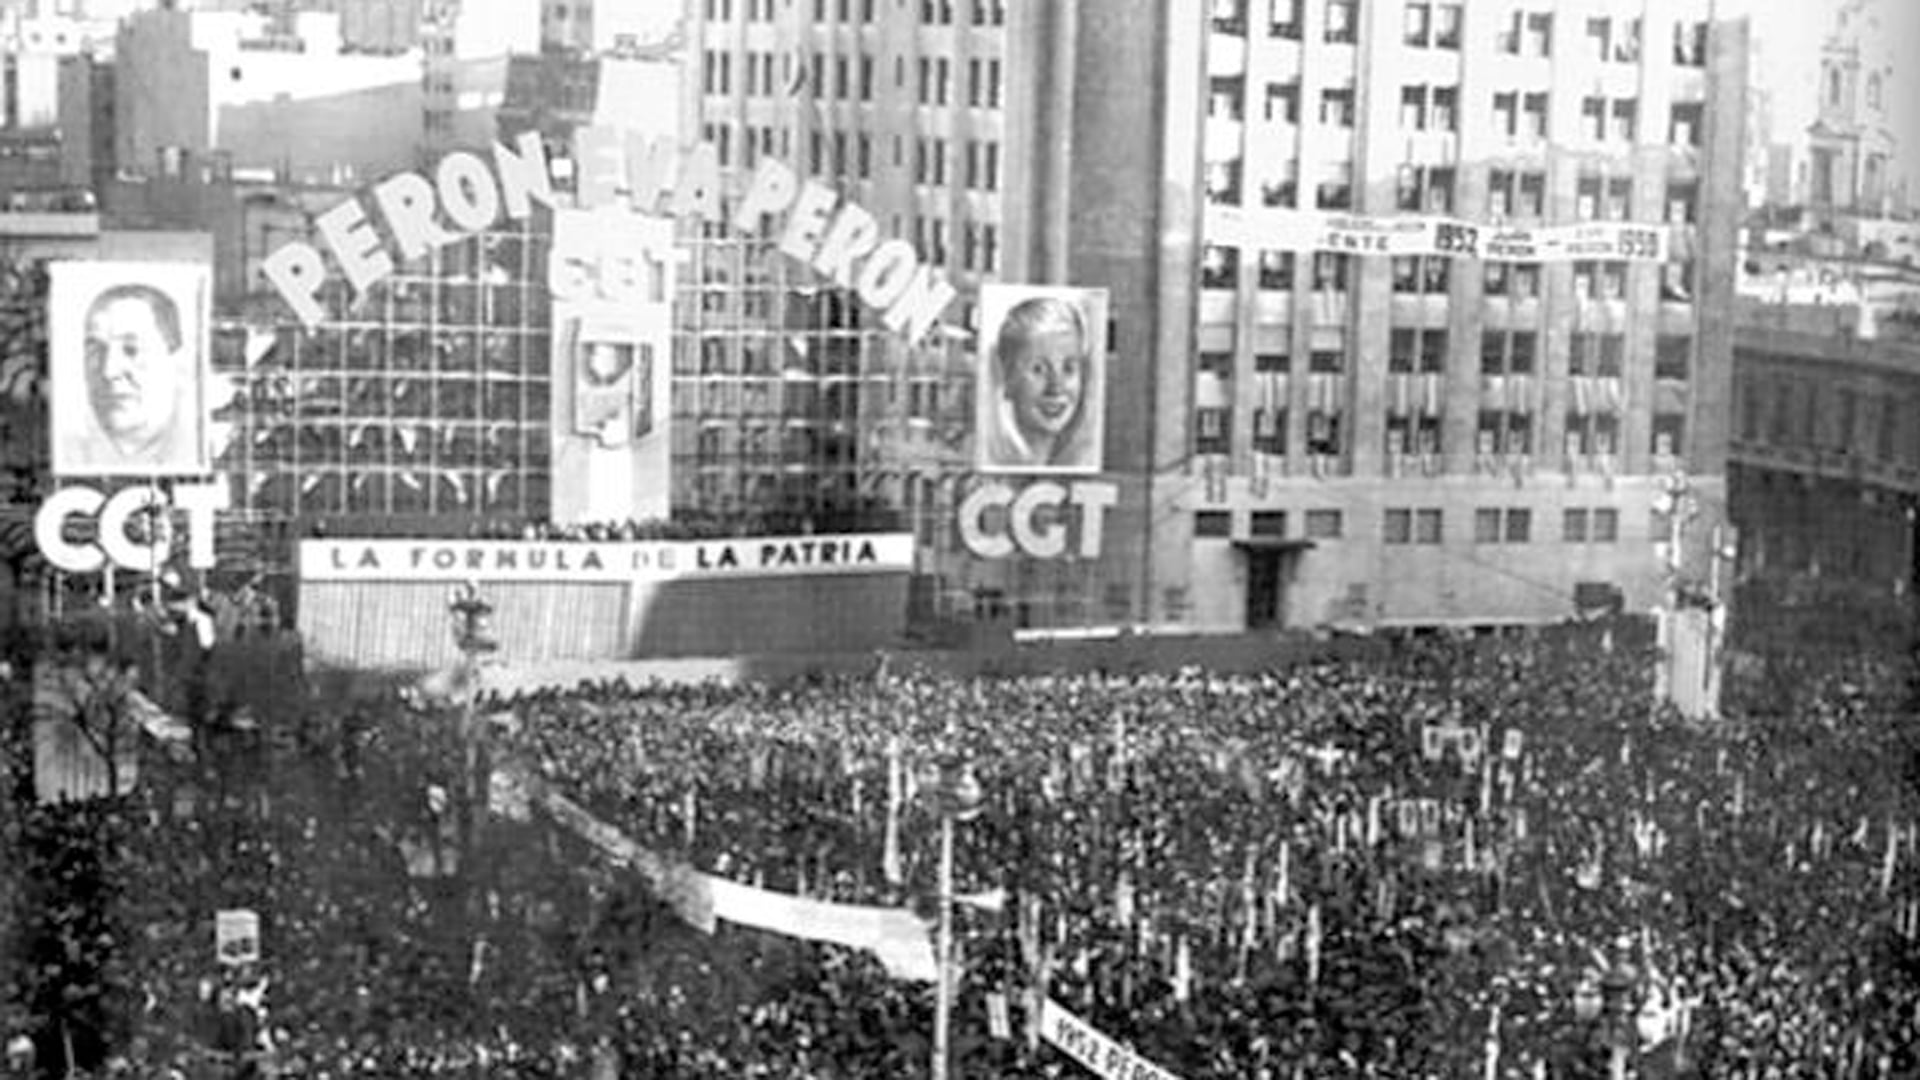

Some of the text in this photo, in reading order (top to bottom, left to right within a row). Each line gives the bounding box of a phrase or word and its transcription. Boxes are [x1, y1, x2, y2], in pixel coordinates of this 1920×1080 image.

[574, 125, 721, 222] EVA
[263, 130, 560, 334] PERON
[734, 154, 958, 347] PERON
[331, 540, 877, 571] LA FORMULA DE LA PATRIA
[957, 480, 1119, 560] CGT
